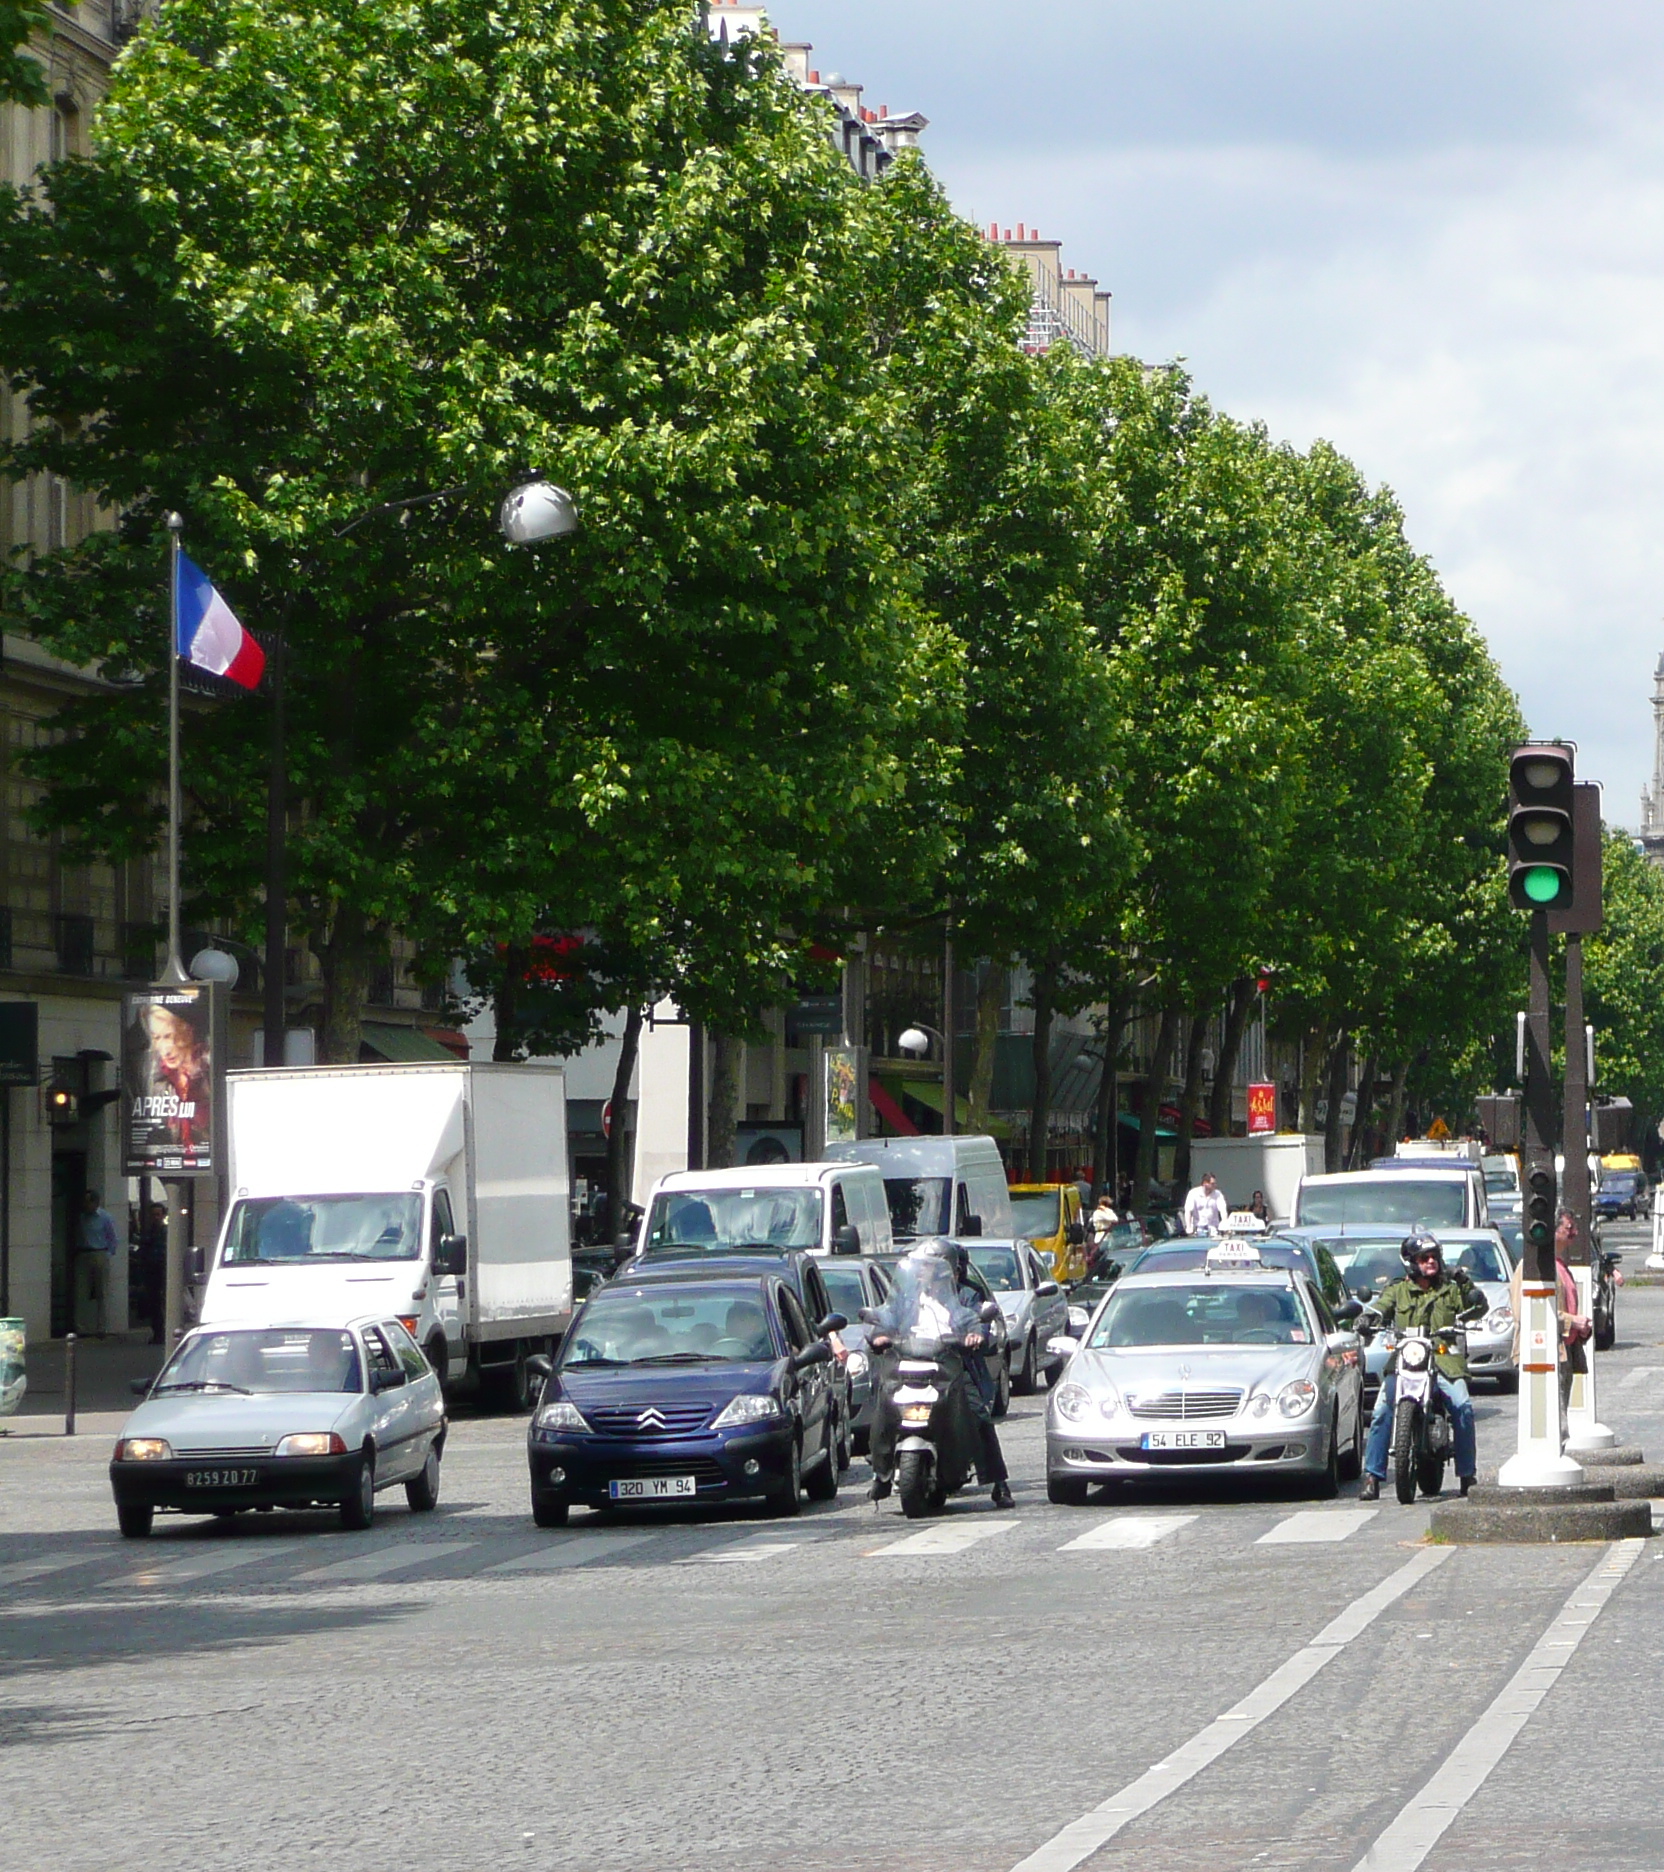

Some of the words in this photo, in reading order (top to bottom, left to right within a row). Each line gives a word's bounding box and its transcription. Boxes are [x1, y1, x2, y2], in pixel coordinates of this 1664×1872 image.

[132, 1091, 179, 1118] APRÈS
[1234, 1215, 1252, 1223] TAXI
[1224, 1243, 1245, 1252] TAXI
[1152, 1434, 1166, 1447] 54
[1175, 1433, 1198, 1447] ELE
[1206, 1433, 1222, 1447] 92
[187, 1472, 220, 1485] 8259
[241, 1469, 257, 1485] 77
[620, 1482, 643, 1496] 320
[652, 1480, 668, 1495] YM
[676, 1480, 692, 1493] 94
